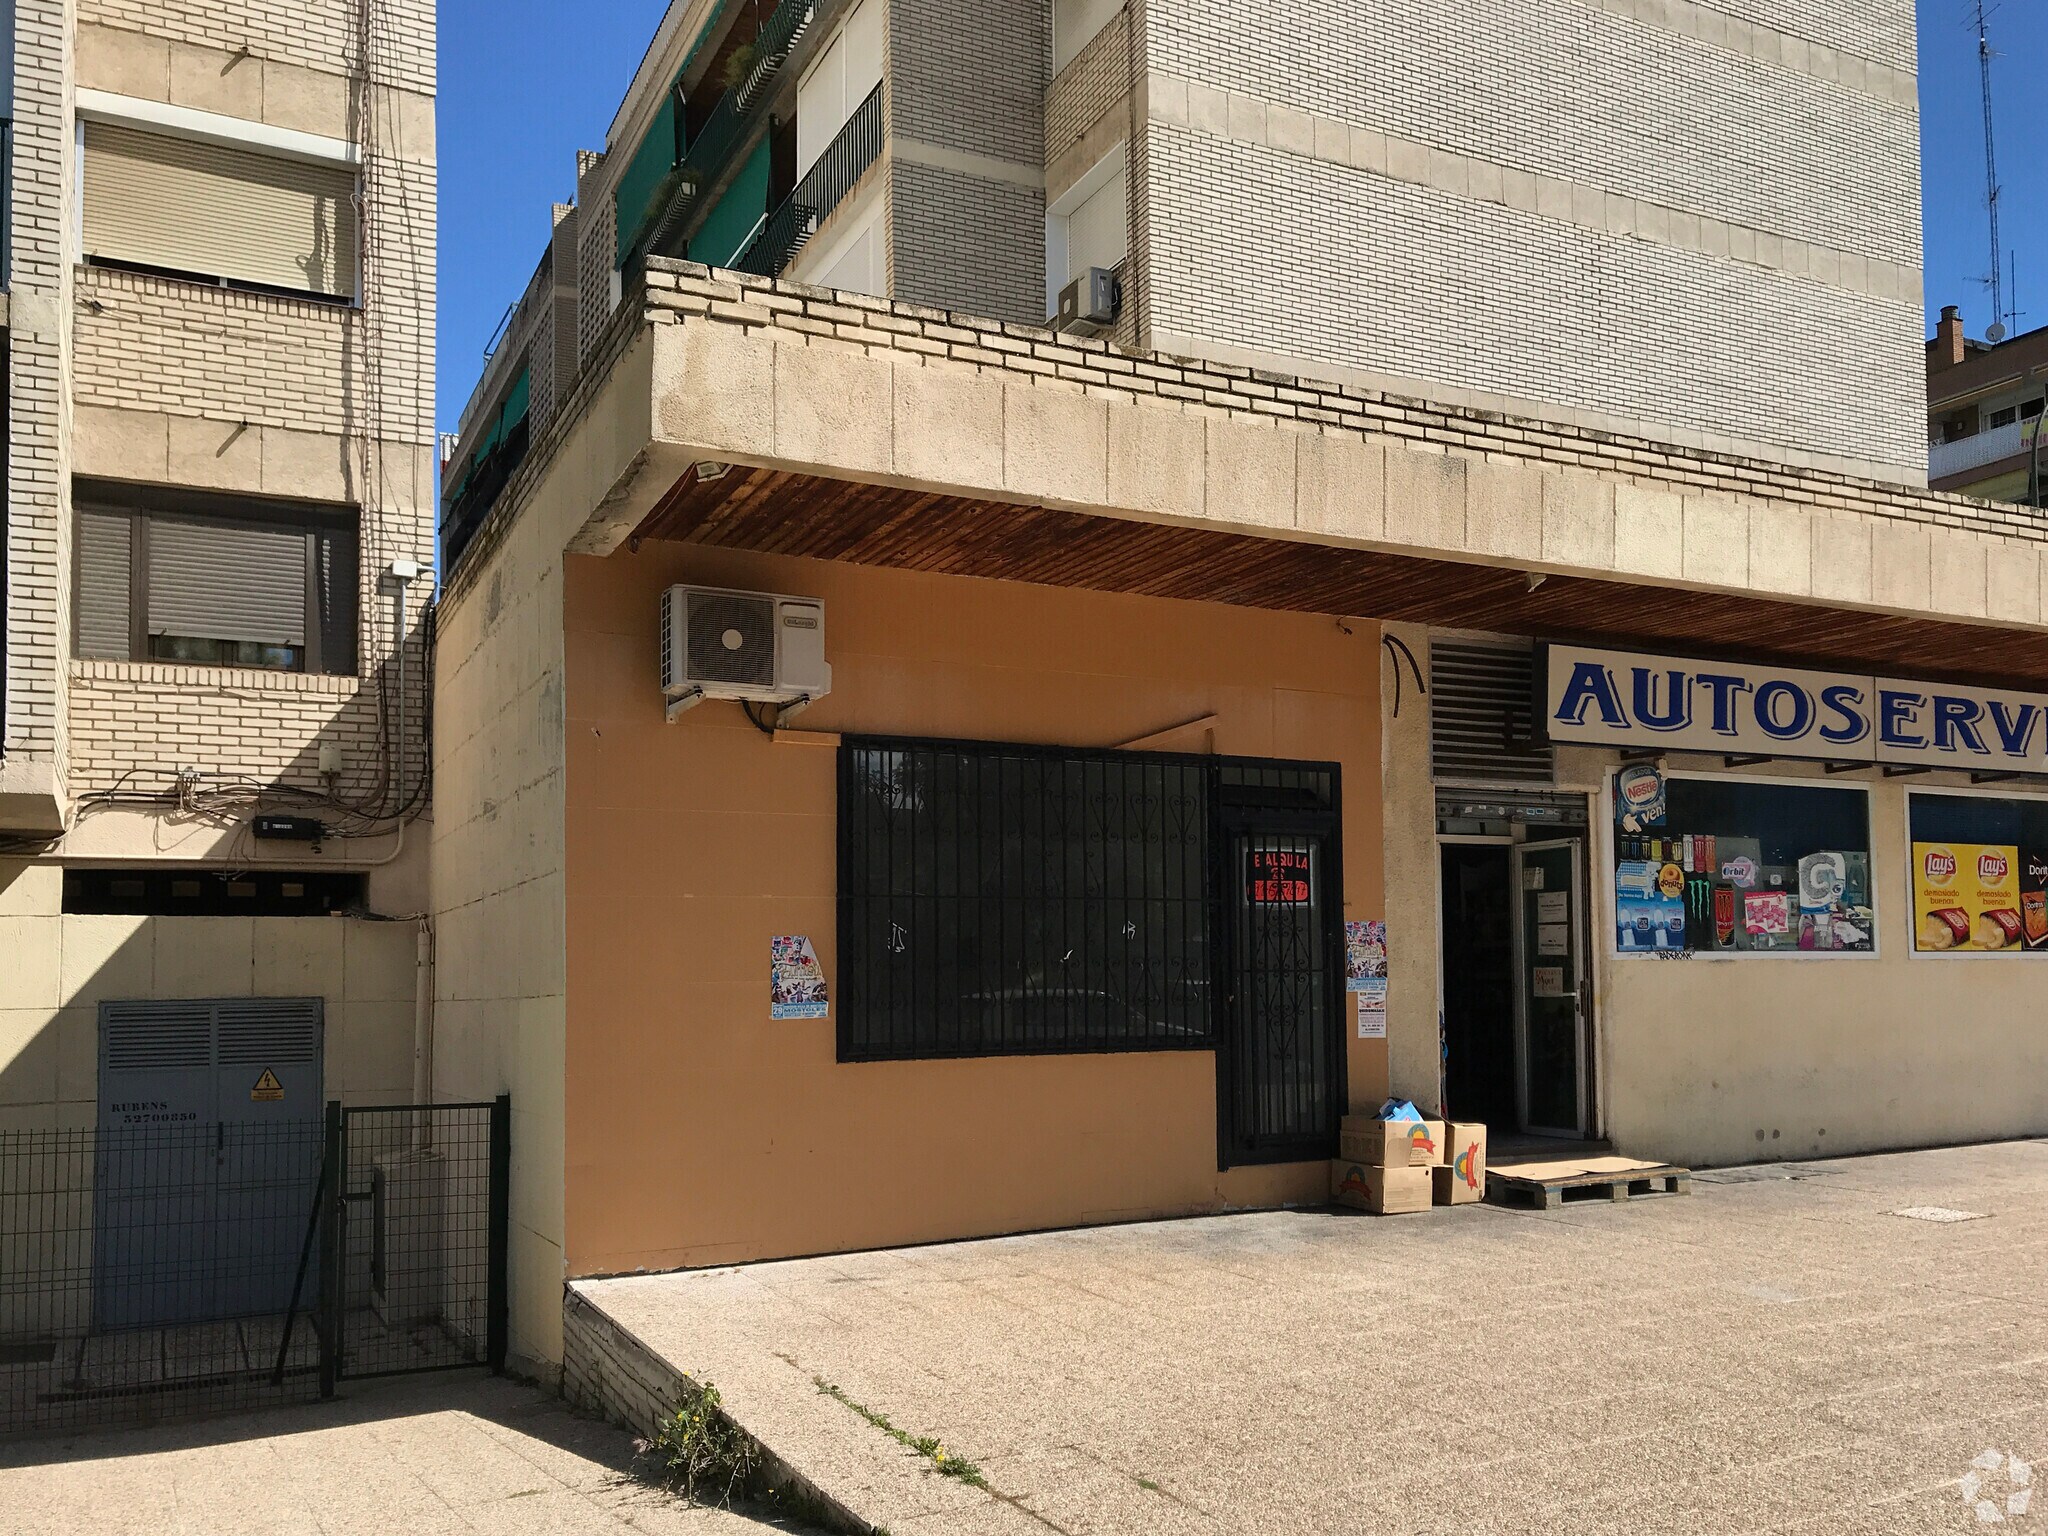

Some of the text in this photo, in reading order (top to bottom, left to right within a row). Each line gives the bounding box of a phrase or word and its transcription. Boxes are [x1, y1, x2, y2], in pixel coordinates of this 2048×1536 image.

[1641, 803, 1666, 823] ven!
[1927, 854, 1954, 875] Lay's
[1980, 856, 2006, 876] Lay's
[1723, 867, 1745, 876] Orbit
[1660, 879, 1683, 890] donuts
[1923, 889, 1960, 897] demasiado
[1976, 890, 2012, 898] demasiado
[1983, 898, 2006, 906] buenas
[111, 1101, 168, 1112] RUBENS
